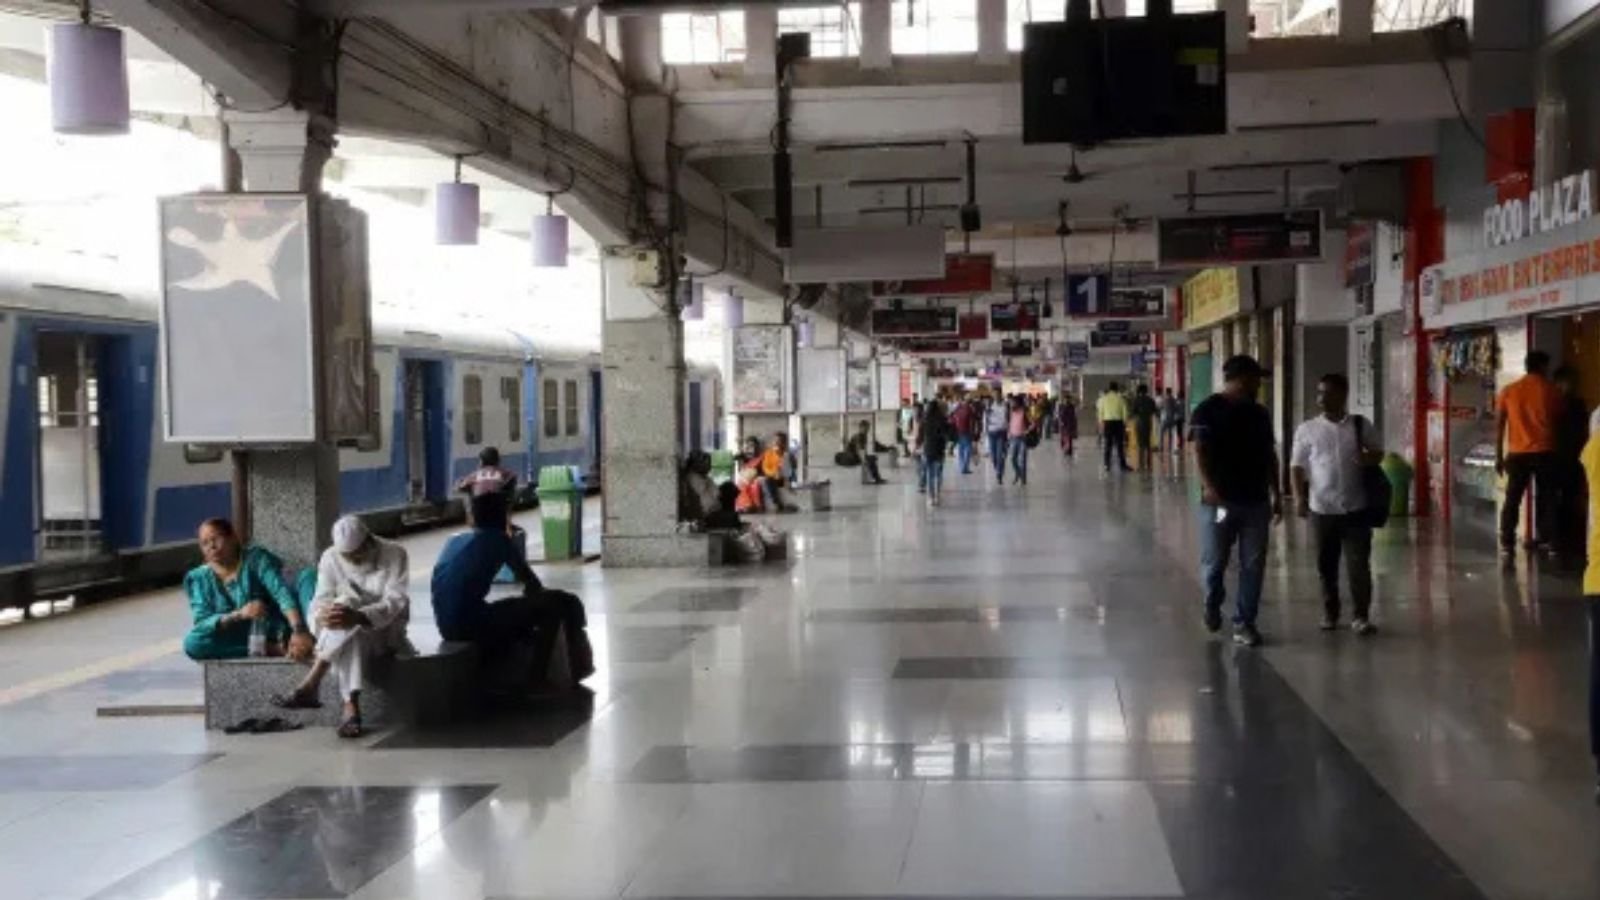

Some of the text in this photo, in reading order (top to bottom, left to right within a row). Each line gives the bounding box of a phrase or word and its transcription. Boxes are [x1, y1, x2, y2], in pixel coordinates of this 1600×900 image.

[1484, 169, 1592, 248] FOOD PLAZA
[1077, 277, 1097, 313] 1
